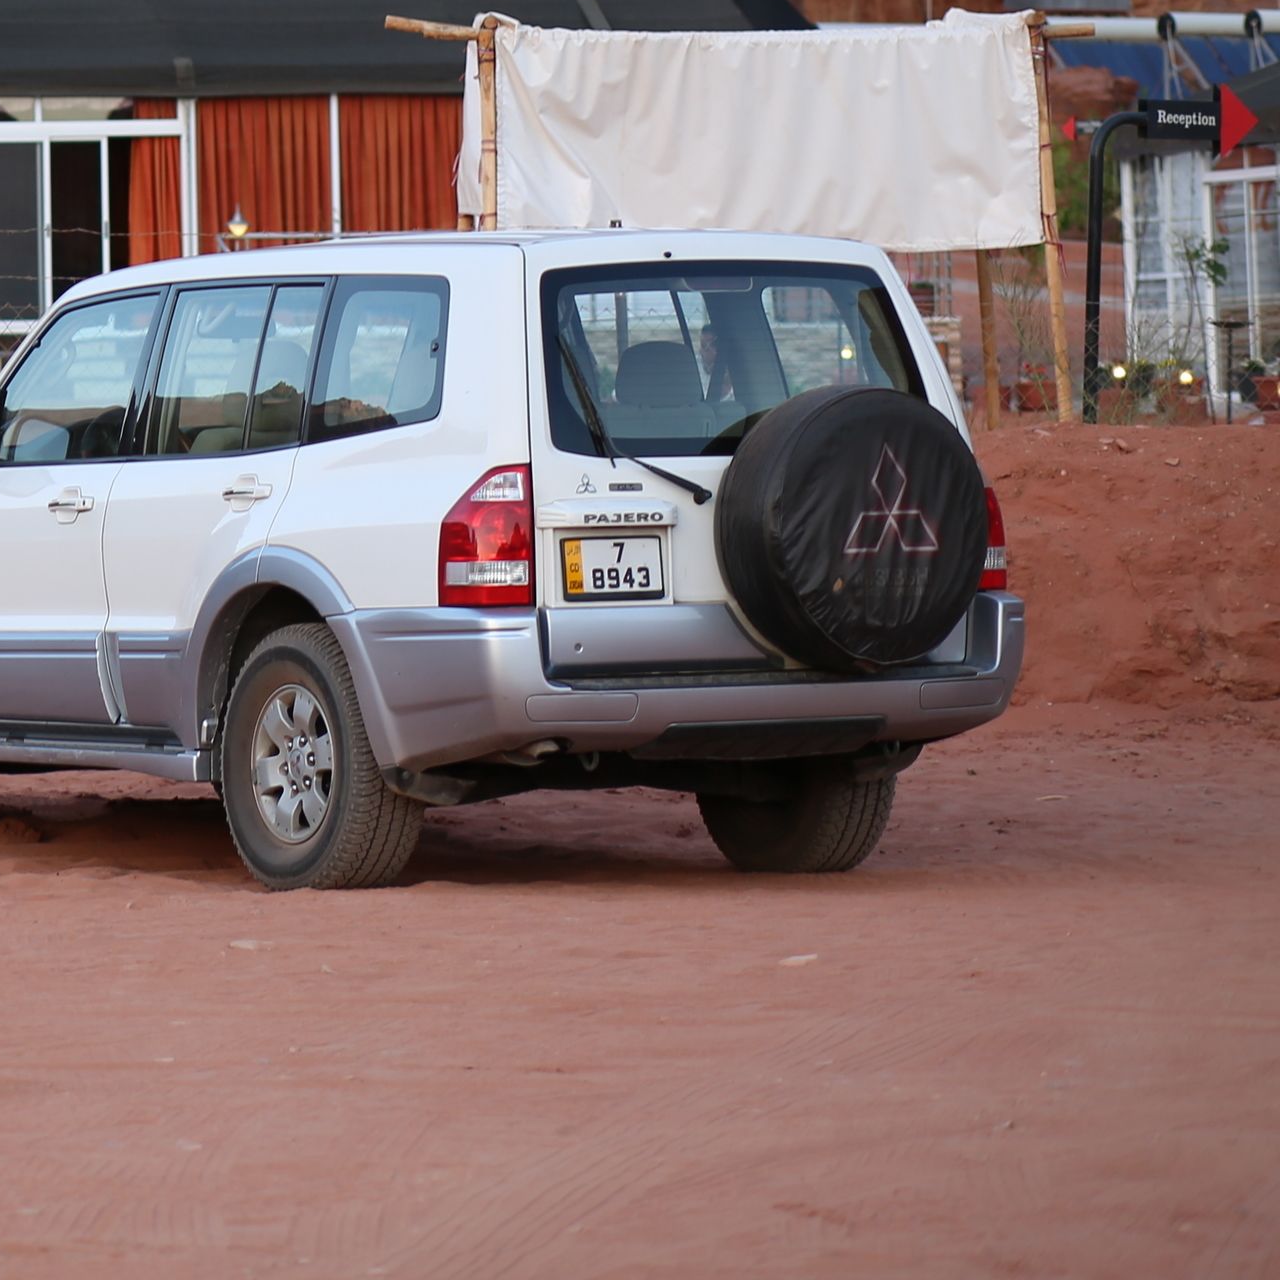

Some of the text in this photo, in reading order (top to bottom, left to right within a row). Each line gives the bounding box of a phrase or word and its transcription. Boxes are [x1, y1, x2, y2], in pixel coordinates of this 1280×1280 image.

[1157, 109, 1216, 128] Reception
[583, 512, 664, 524] PAJERO
[612, 542, 625, 564] 7
[592, 566, 650, 590] 8943
